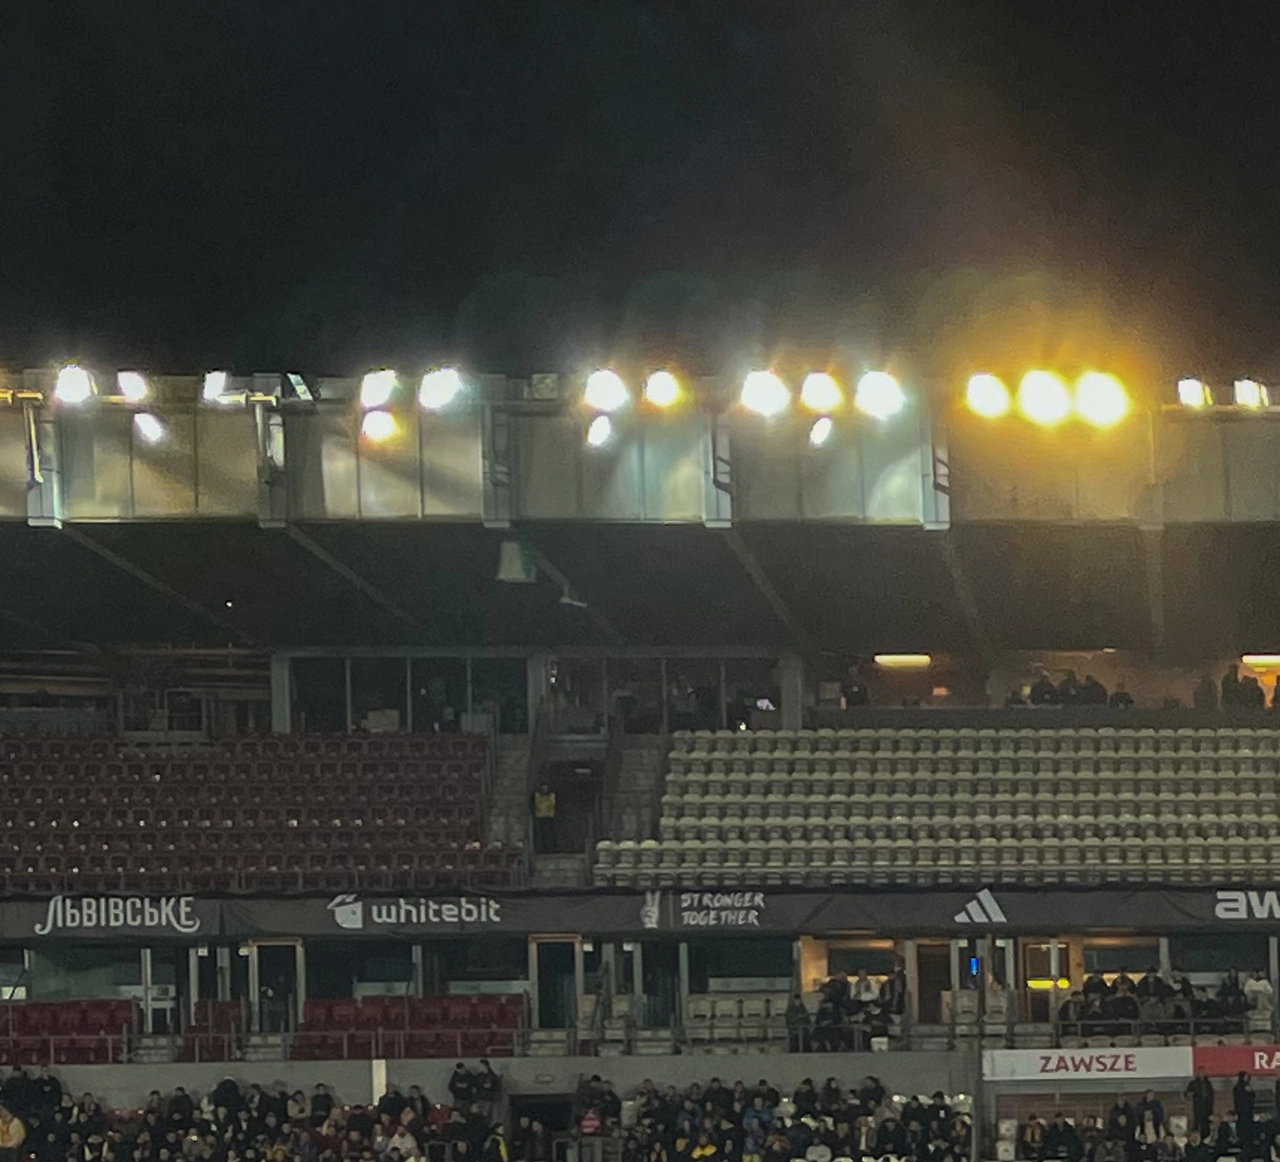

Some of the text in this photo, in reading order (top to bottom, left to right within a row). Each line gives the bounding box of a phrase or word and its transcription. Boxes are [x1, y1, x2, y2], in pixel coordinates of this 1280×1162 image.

[371, 897, 501, 924] whitebit
[680, 891, 766, 909] STRONGER
[34, 895, 200, 934] ЛЬВІВСЬКЕ
[681, 909, 760, 927] TOGETHER
[1039, 1053, 1138, 1074] ZAWSZE
